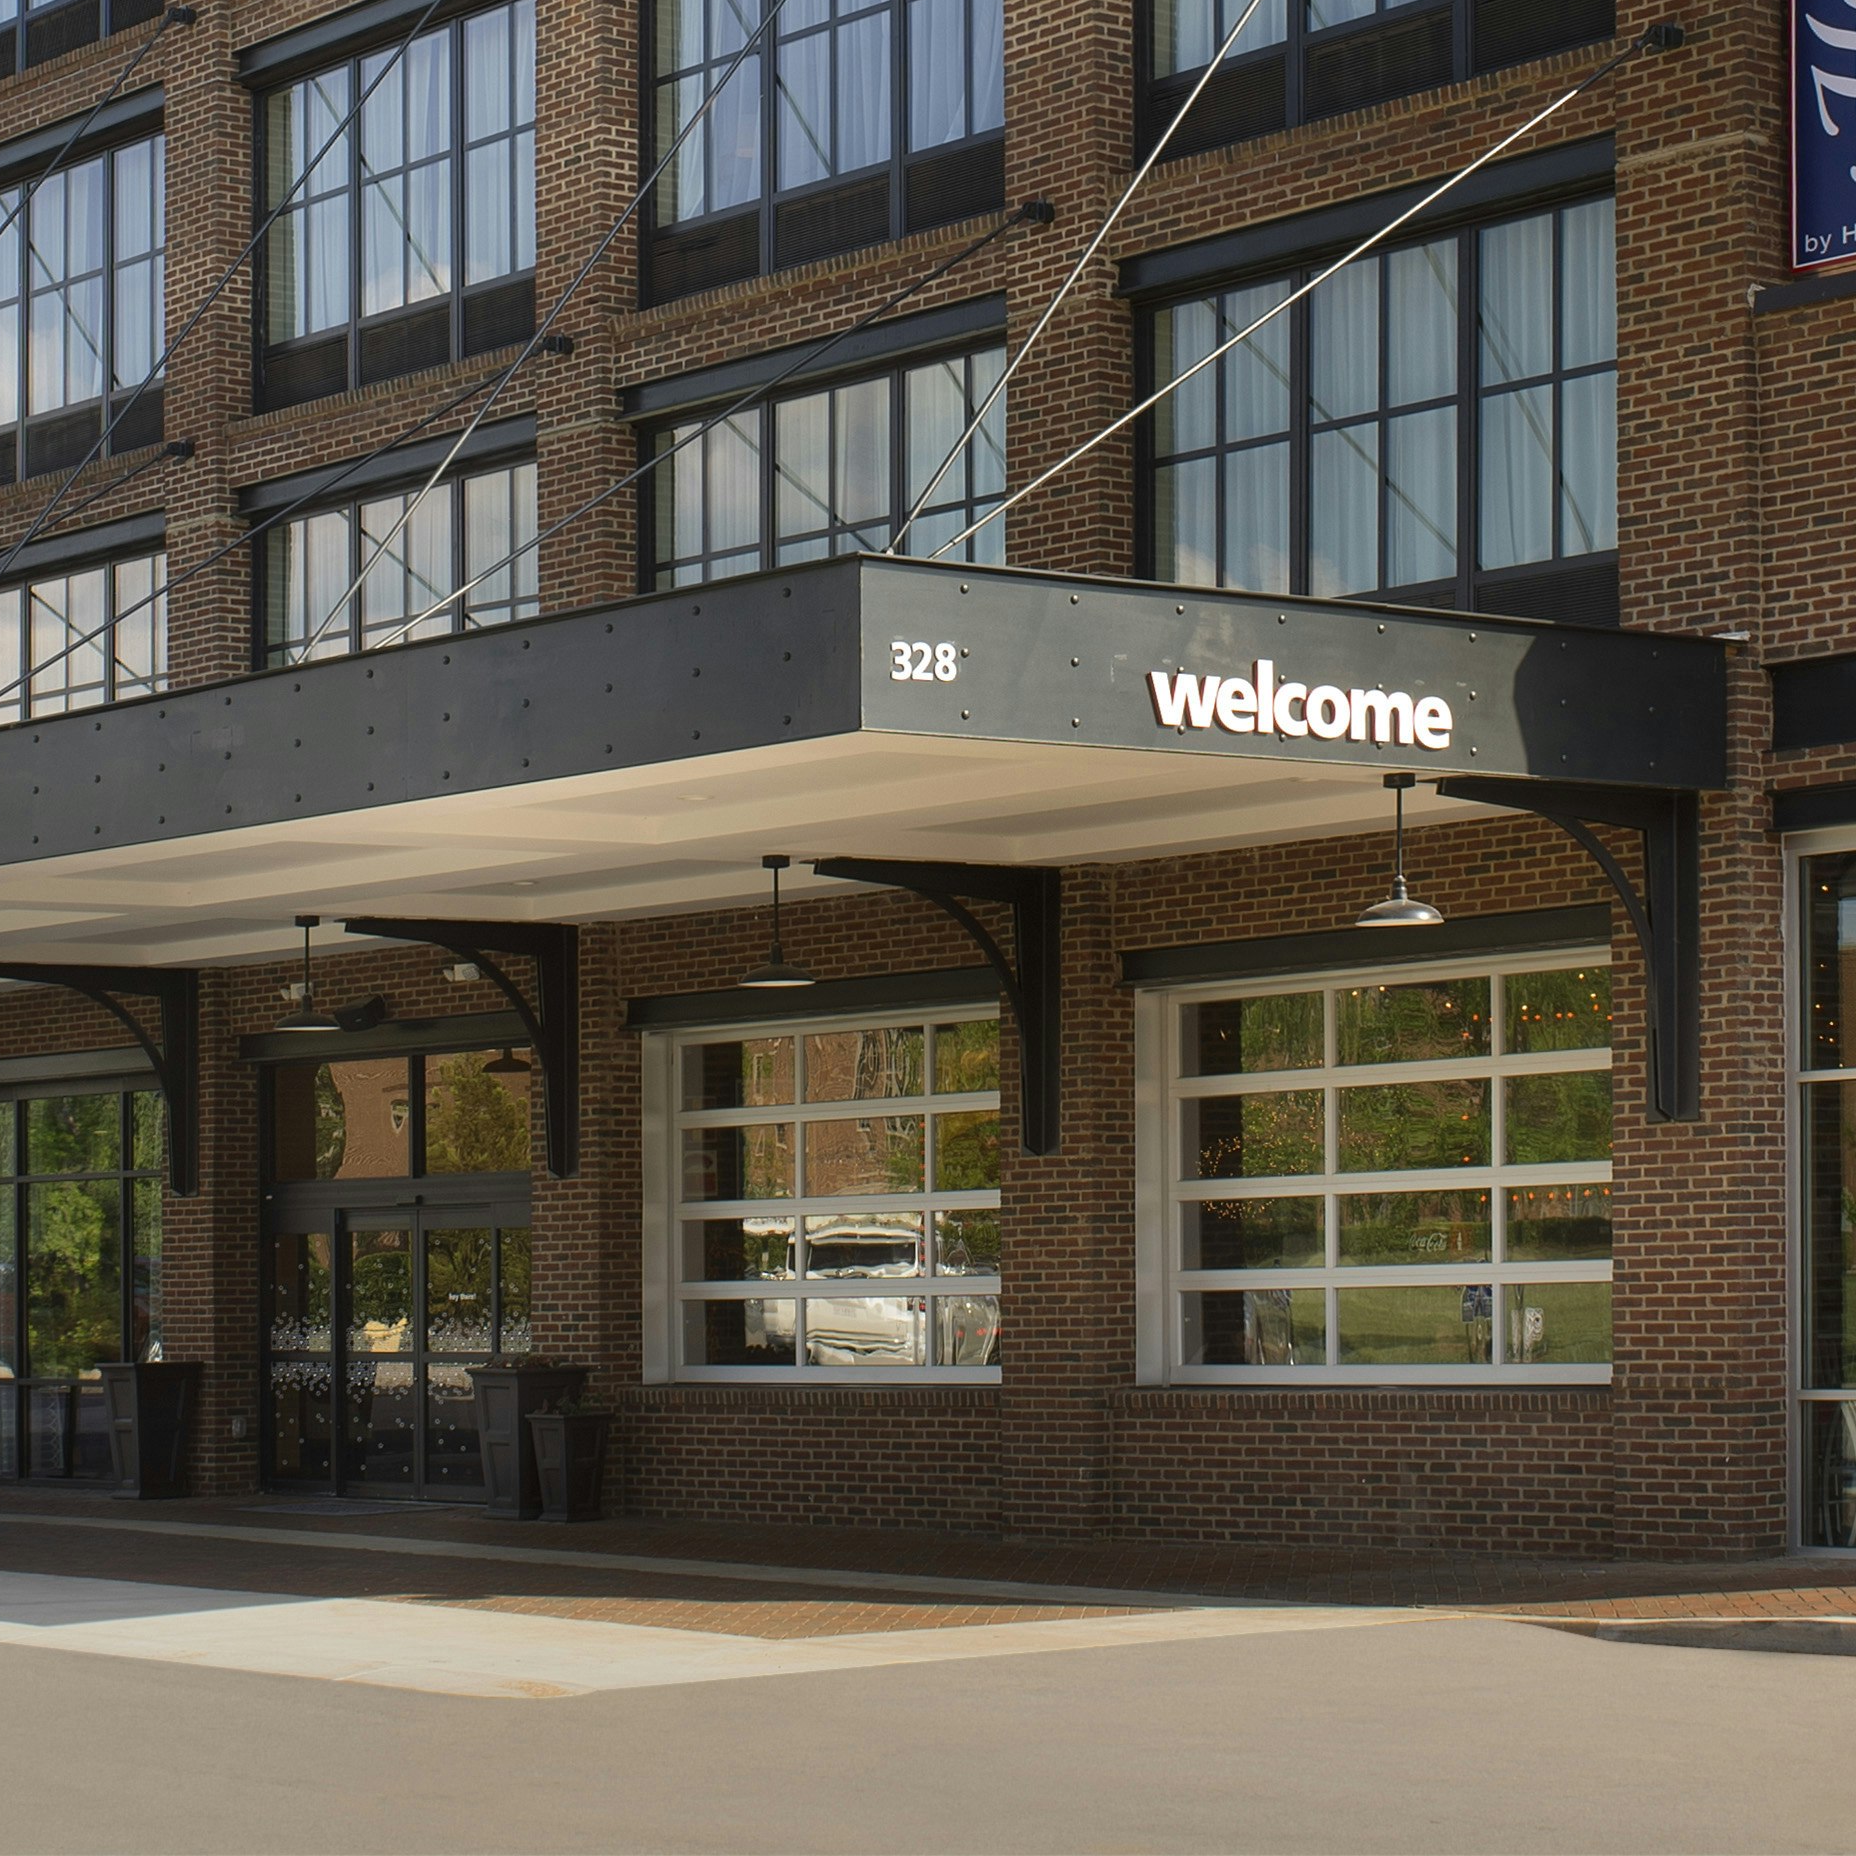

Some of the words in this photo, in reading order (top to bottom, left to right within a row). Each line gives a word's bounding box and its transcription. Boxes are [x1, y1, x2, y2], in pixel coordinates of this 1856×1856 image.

[1804, 232, 1832, 255] by
[889, 640, 958, 683] 328
[1147, 659, 1454, 751] welcome
